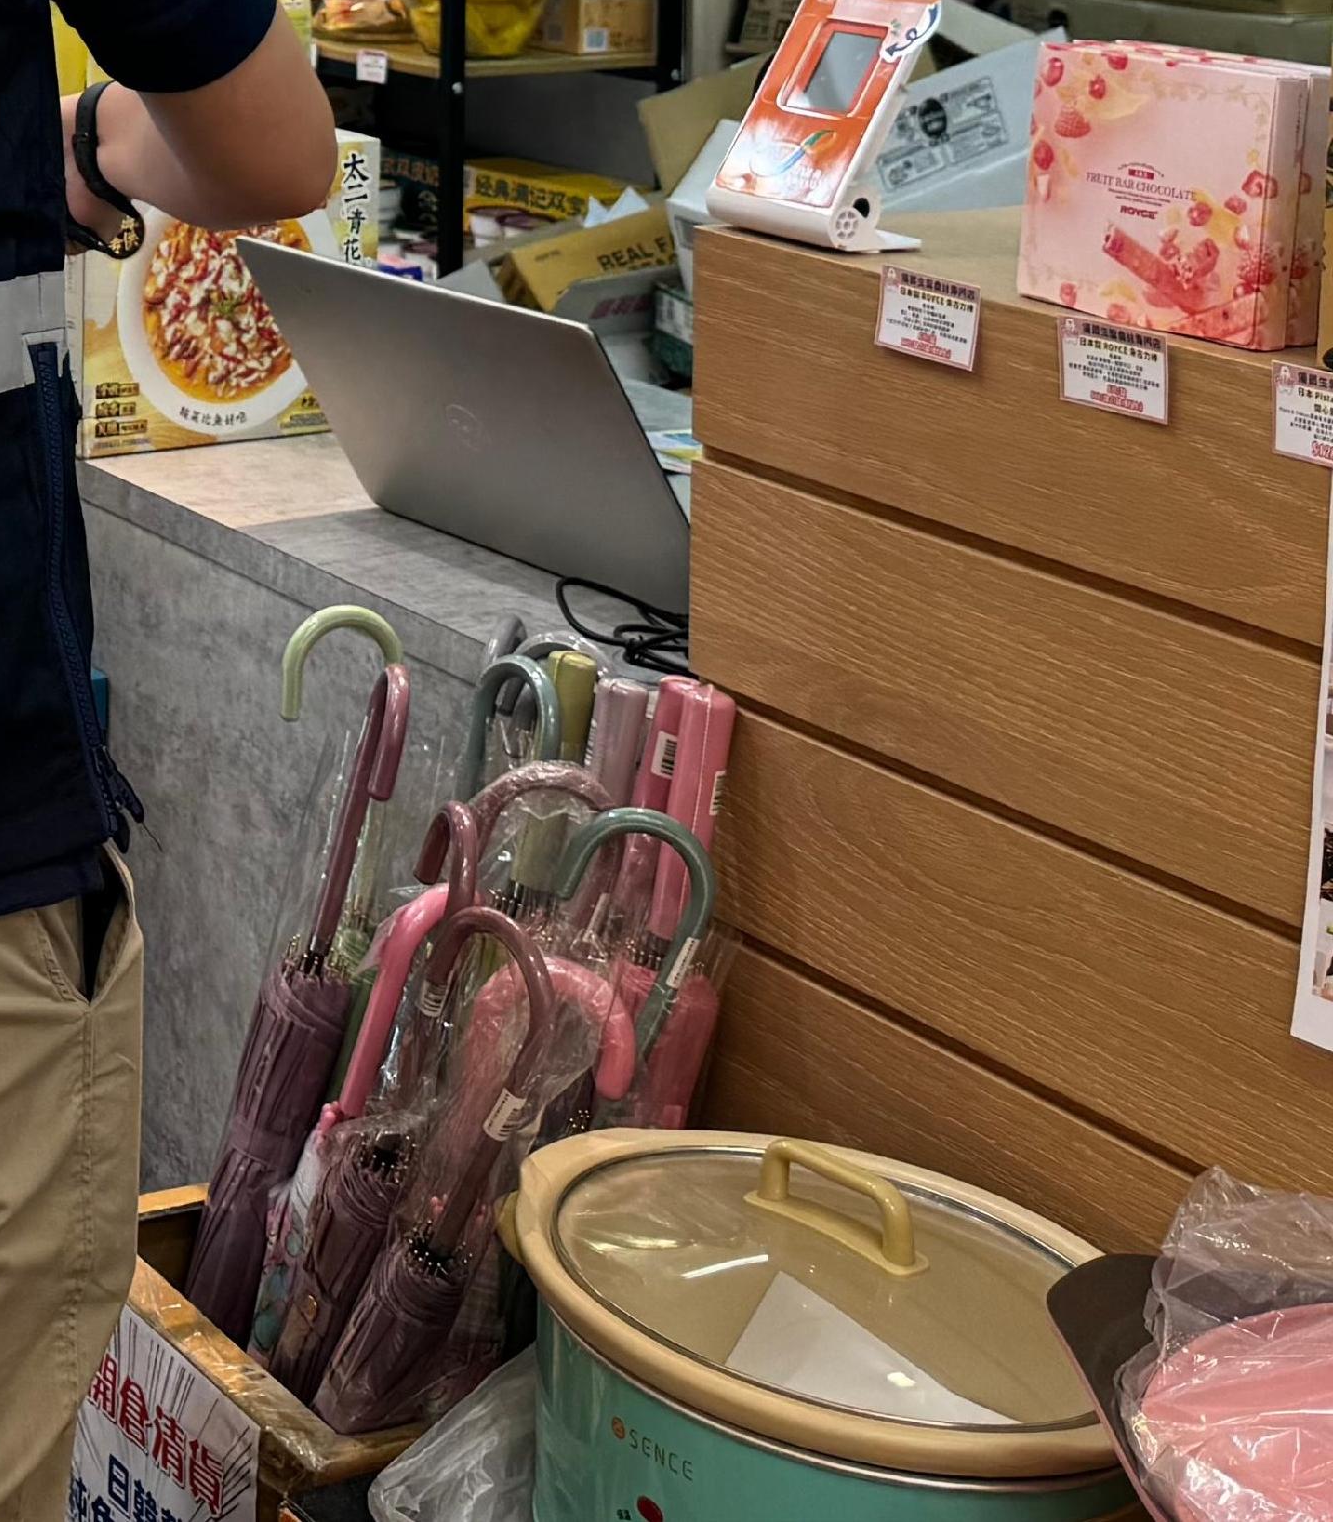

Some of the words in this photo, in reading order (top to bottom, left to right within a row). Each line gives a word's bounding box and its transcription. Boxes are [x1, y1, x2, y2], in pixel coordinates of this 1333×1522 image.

[1086, 172, 1114, 186] FRUIT
[1115, 177, 1134, 191] BAR
[1136, 180, 1198, 201] CHOCOLATE
[597, 245, 654, 271] REAL
[90, 1353, 223, 1515] 開倉清貨
[108, 1454, 183, 1522] 日韓
